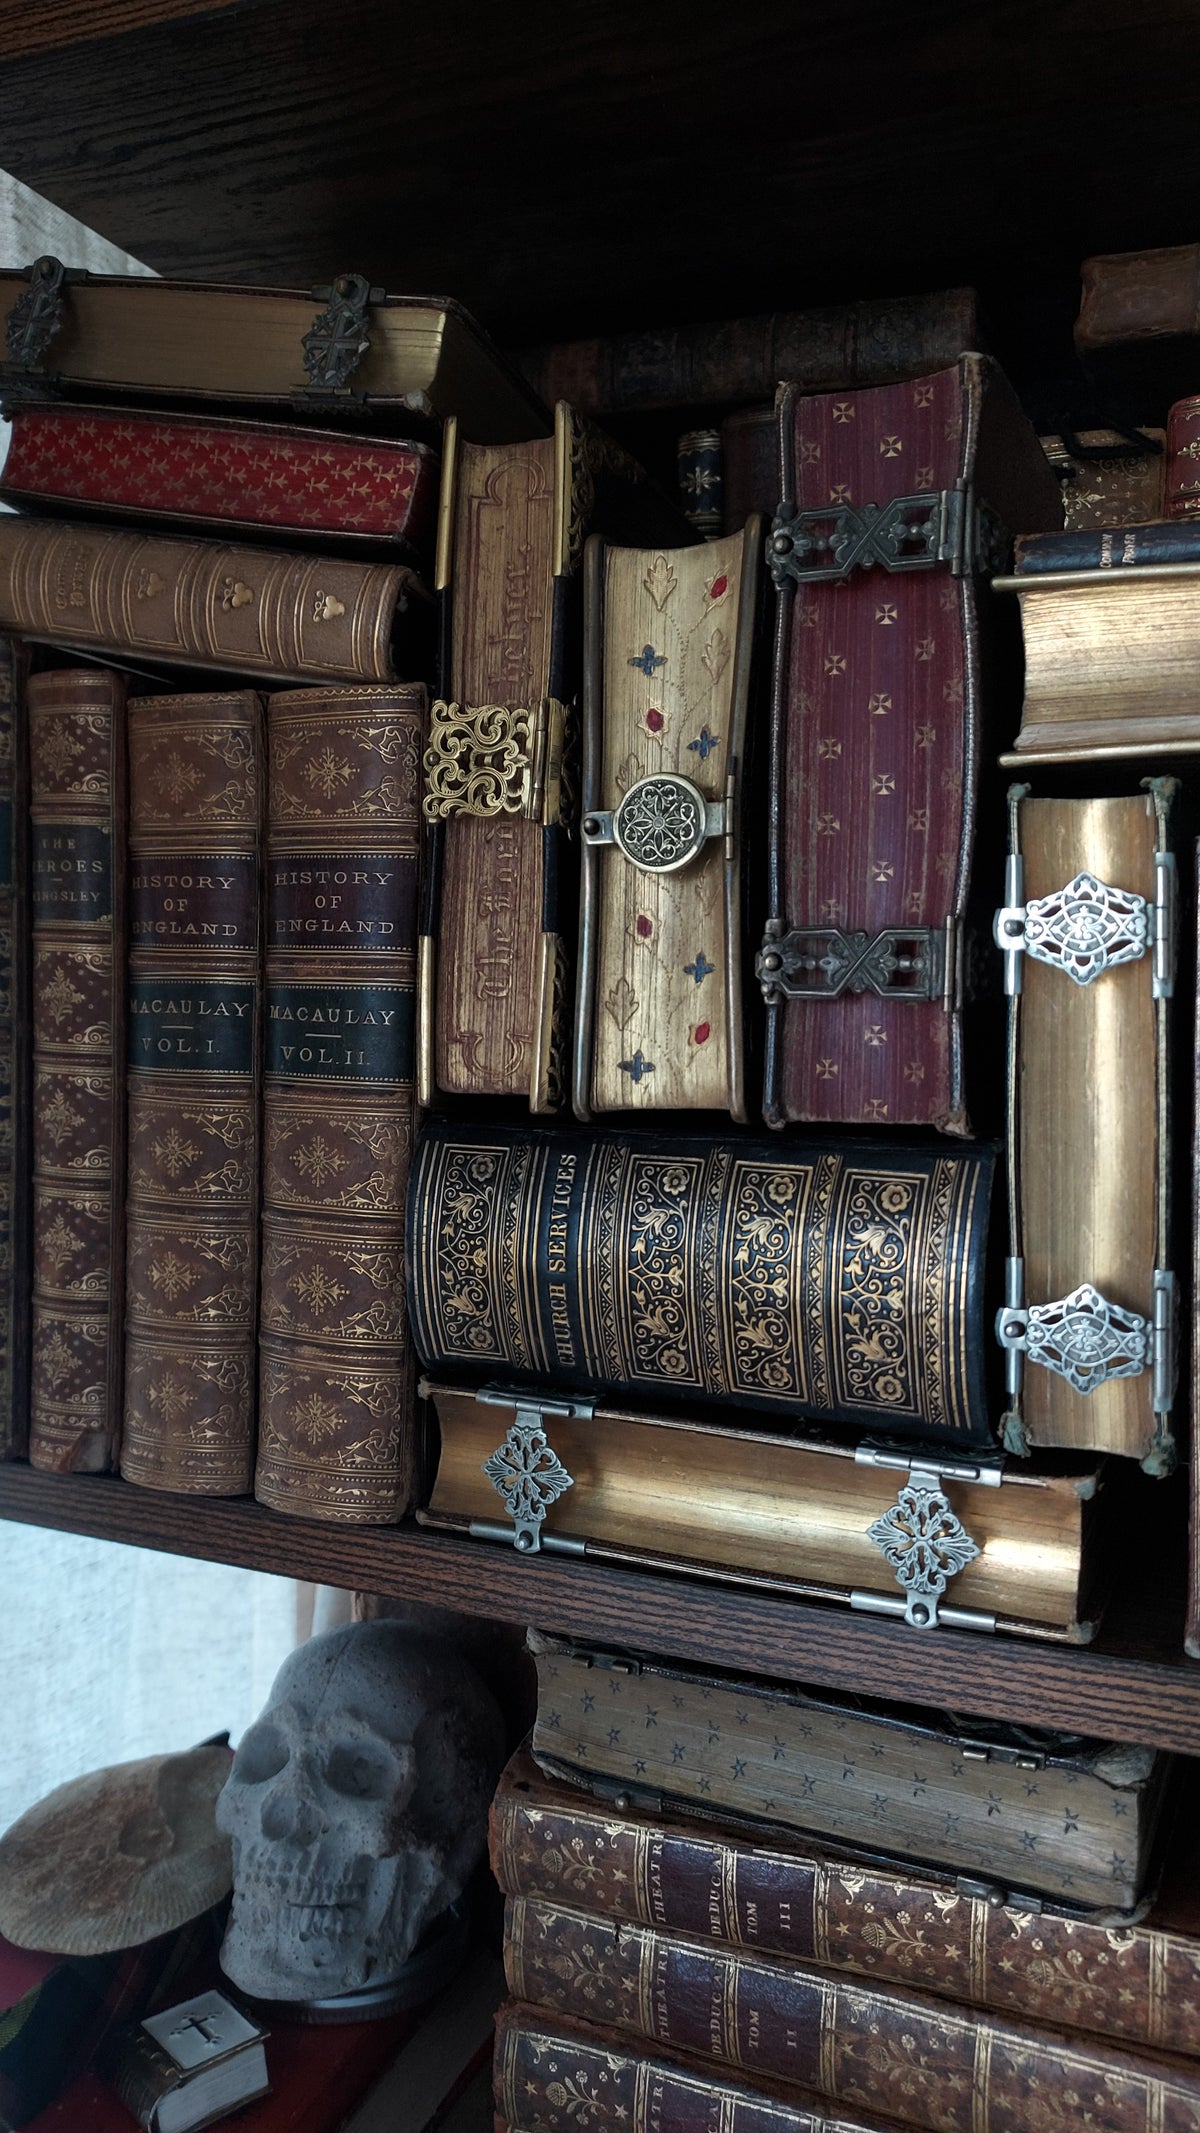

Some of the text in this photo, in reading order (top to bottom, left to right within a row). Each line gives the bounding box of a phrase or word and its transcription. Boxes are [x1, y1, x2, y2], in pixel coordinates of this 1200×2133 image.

[40, 838, 76, 849] THE
[132, 875, 238, 890] HISTORY
[275, 871, 394, 886] HISTORY
[163, 898, 188, 912] OF
[315, 895, 343, 909] OF
[132, 921, 238, 937] ENGLAND
[275, 919, 394, 935] ENGLAND
[130, 1000, 249, 1017] MACAULAY
[270, 1005, 395, 1026] MACAULAY
[548, 1154, 577, 1367] CHURCH SERVICES
[745, 1901, 758, 1935] TOM
[779, 1902, 791, 1930] III
[749, 2009, 760, 2048] TOM
[787, 2029, 798, 2048] II
